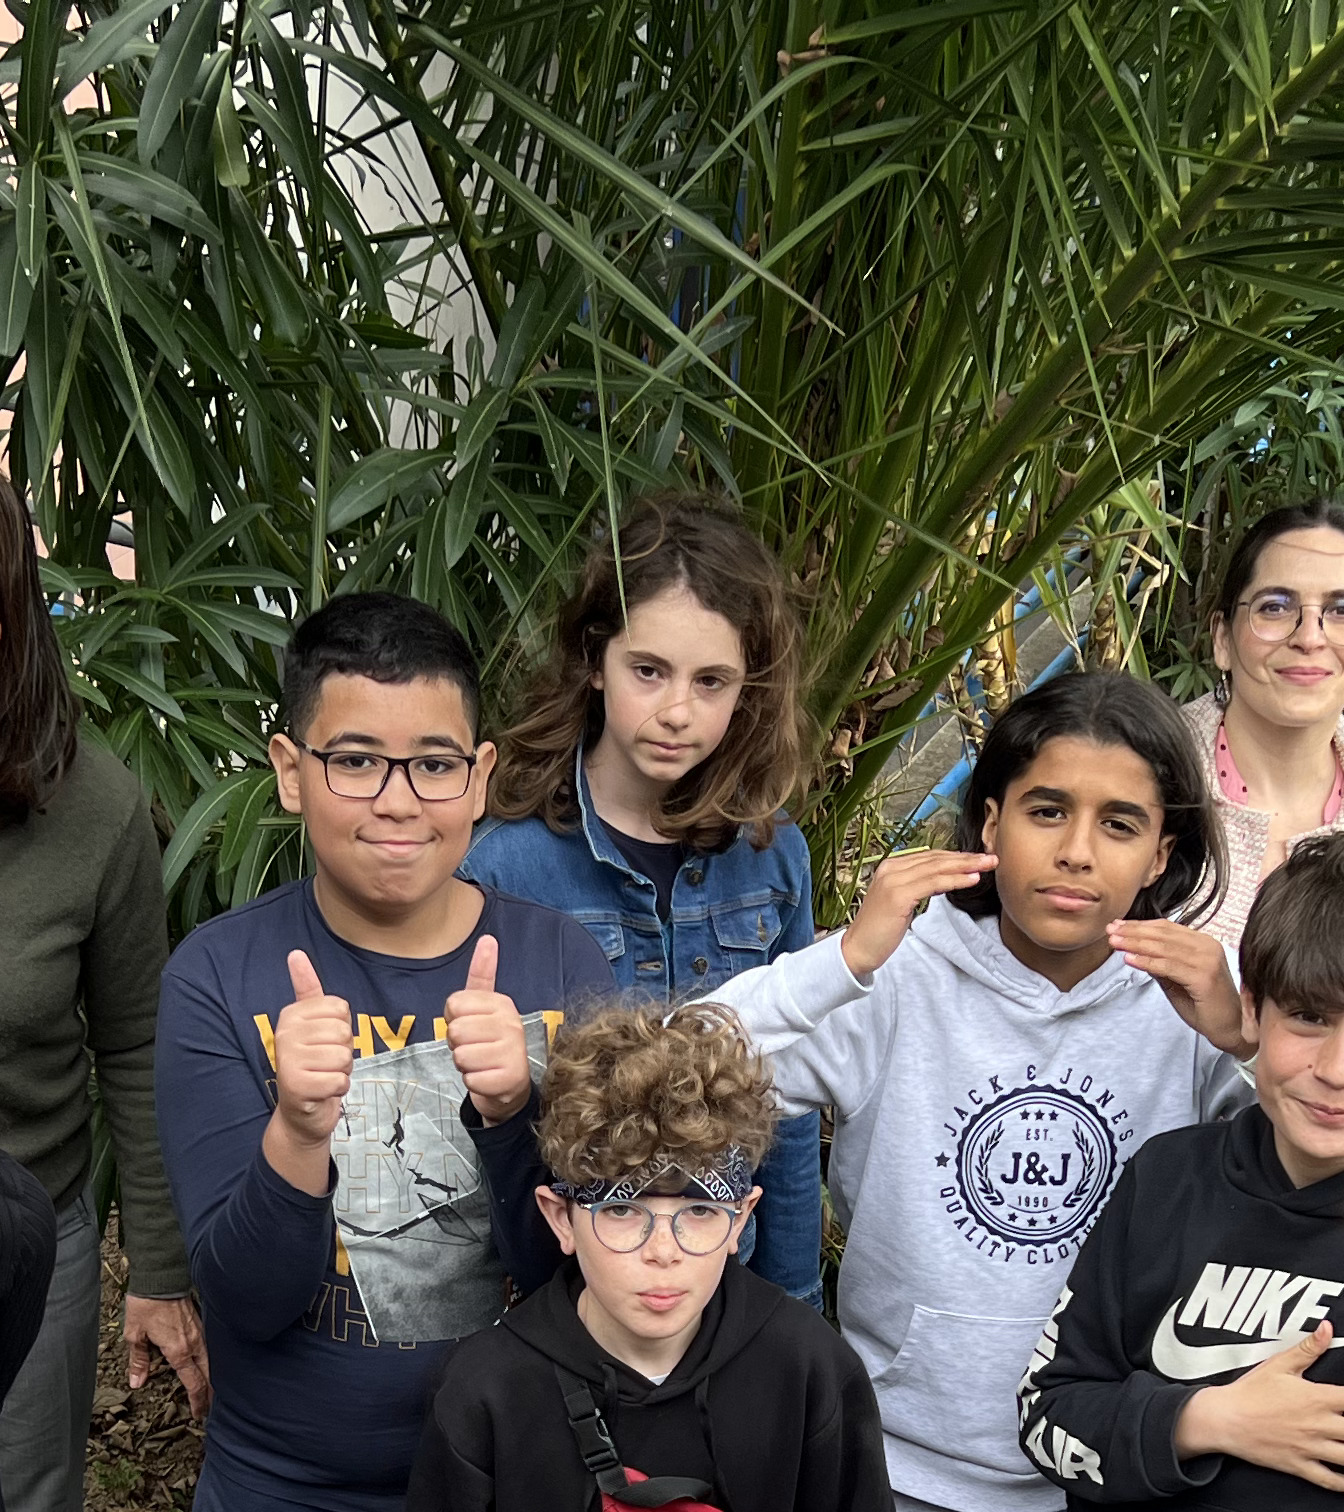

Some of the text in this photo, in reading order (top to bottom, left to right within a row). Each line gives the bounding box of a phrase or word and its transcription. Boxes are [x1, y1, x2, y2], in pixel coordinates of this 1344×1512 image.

[943, 1075, 1004, 1138] JACK
[1059, 1068, 1134, 1143] JONES
[1026, 1128, 1054, 1142] EST.
[1001, 1152, 1071, 1186] J&J
[940, 1186, 1017, 1262] QUALITY
[1017, 1195, 1049, 1208] 1990
[1025, 1416, 1104, 1485] AIR
